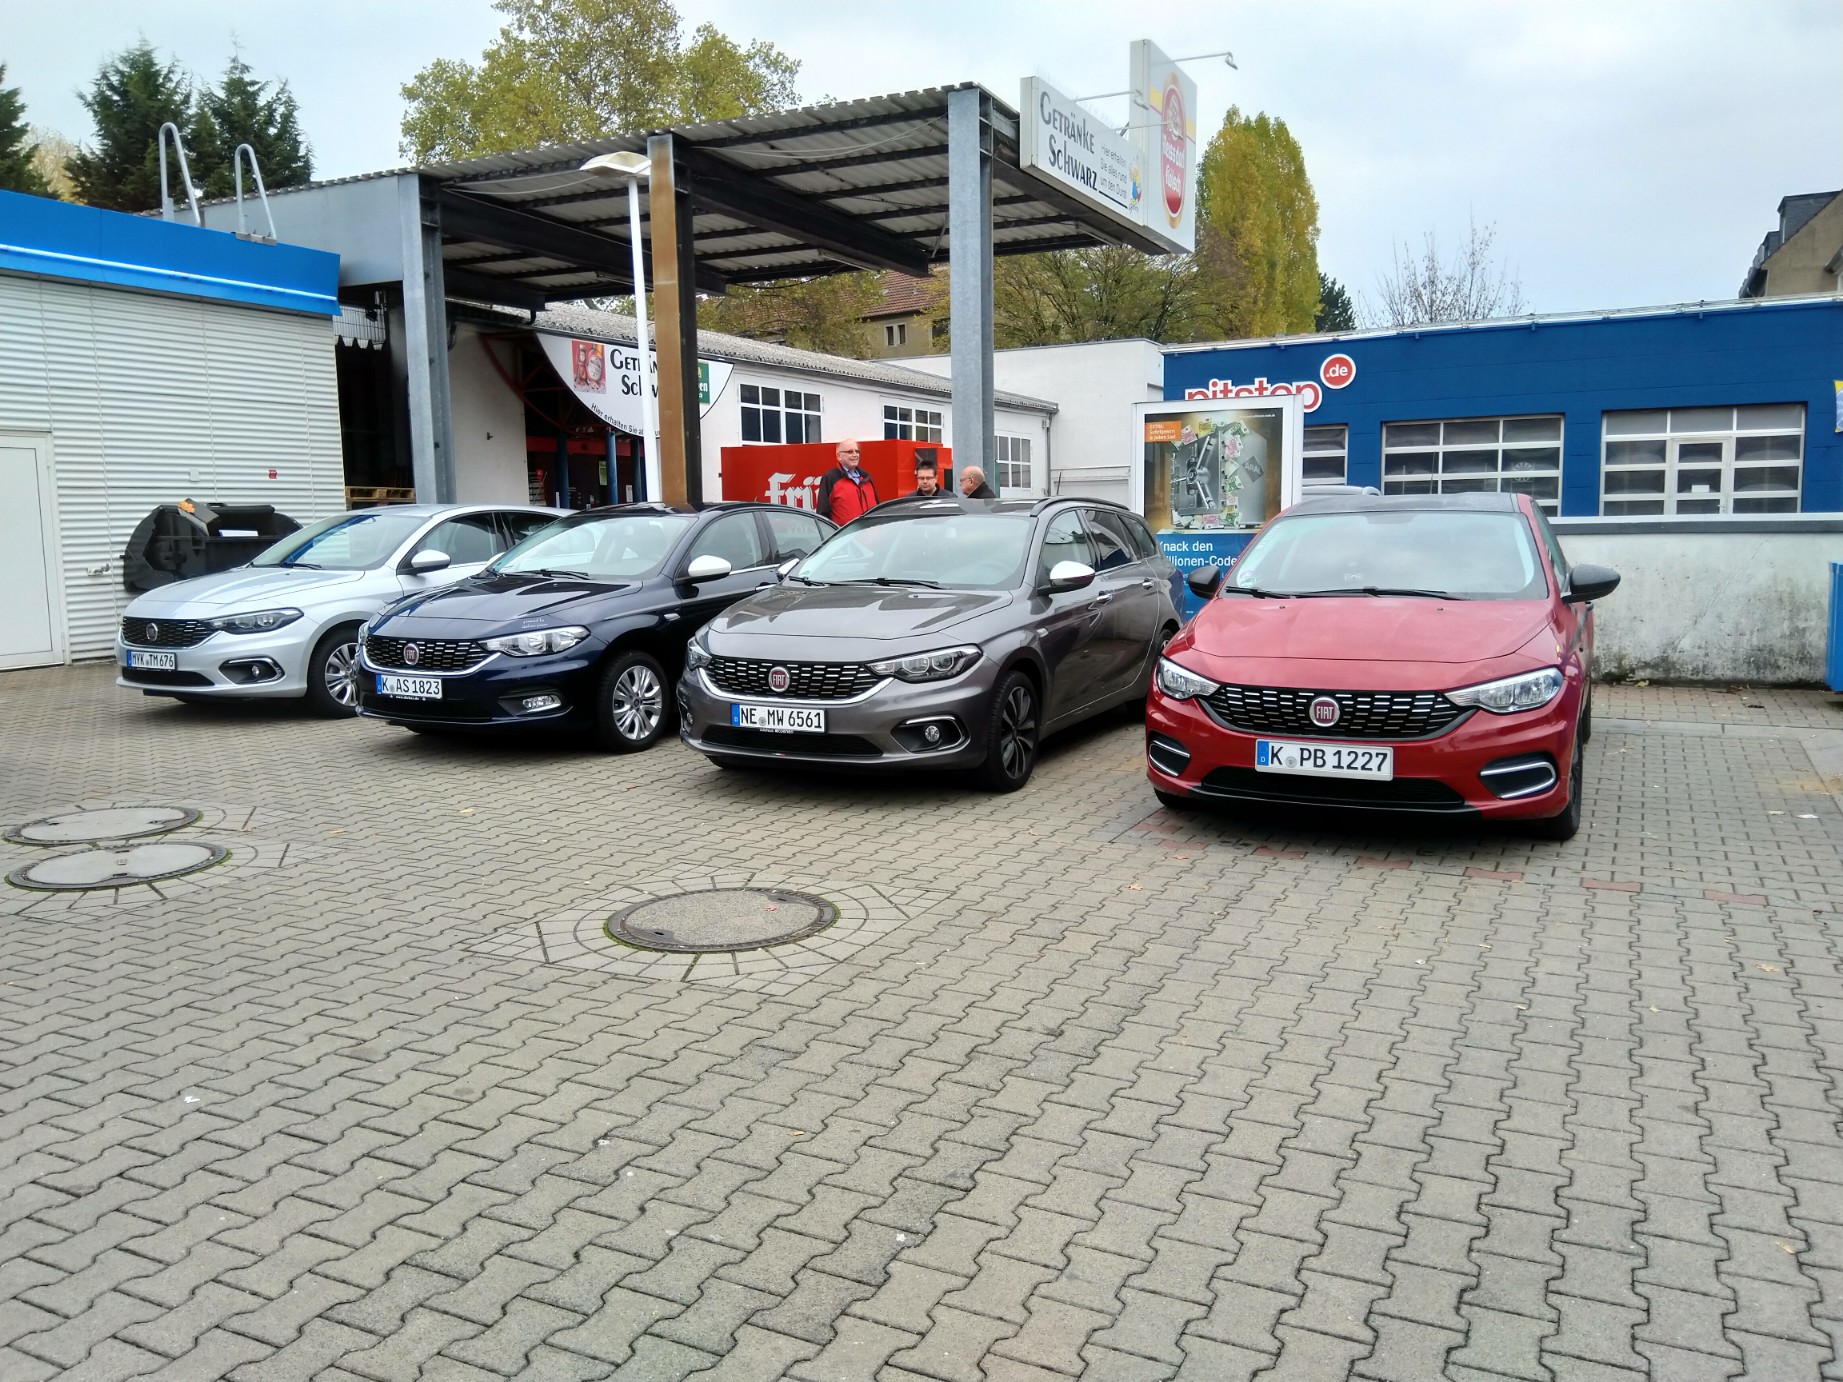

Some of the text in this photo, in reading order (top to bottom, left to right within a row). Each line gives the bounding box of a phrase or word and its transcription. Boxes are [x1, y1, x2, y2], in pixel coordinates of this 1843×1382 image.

[1326, 363, 1348, 377] .de
[591, 402, 603, 416] Hier
[604, 414, 627, 430] erhalten
[628, 424, 638, 434] Sie
[1192, 541, 1214, 552] den
[1166, 555, 1238, 567] illionen-Code
[148, 653, 159, 667] TM
[159, 654, 174, 668] 676
[382, 677, 389, 691] K
[396, 678, 410, 693] AS
[411, 679, 440, 695] 1823
[772, 674, 786, 686] FIAT
[740, 707, 758, 725] NE
[767, 709, 784, 726] MW
[788, 710, 822, 729] 6561
[1316, 705, 1334, 720] FIAT
[1270, 745, 1284, 766] K
[1299, 747, 1327, 768] PB
[1332, 750, 1388, 772] 1227
